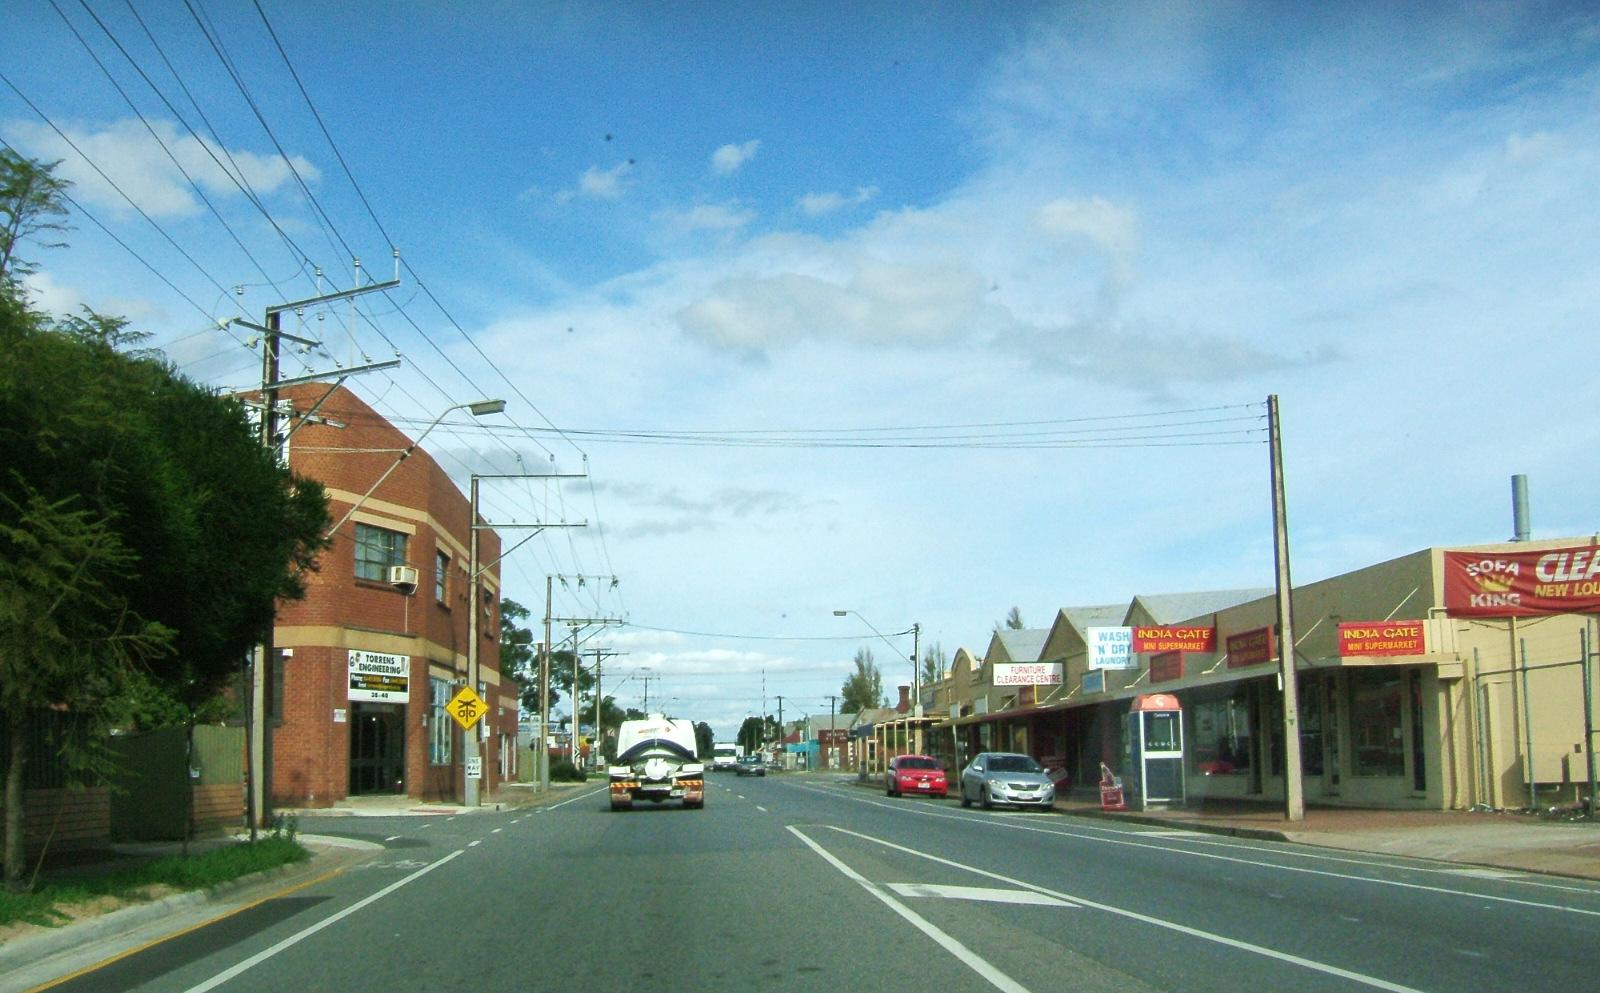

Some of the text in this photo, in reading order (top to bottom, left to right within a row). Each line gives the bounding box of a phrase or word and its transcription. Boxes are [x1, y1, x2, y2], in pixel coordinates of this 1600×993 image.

[1465, 559, 1520, 577] SOFA
[1534, 581, 1600, 598] NEW LOU
[1470, 592, 1520, 607] KING
[1097, 631, 1130, 642] WASH
[1137, 629, 1211, 640] INDIA GATE
[1343, 627, 1418, 639] INDIA GATE
[1111, 643, 1132, 655] DRY
[1143, 642, 1205, 651] MINI SUPERMARKET
[1347, 640, 1417, 651] MINI SUPERMARKET
[365, 654, 395, 665] TORRENS
[1095, 656, 1132, 665] LAUNDRY
[358, 663, 401, 675] ENGINEERING
[1010, 665, 1046, 675] FURNITURE
[996, 673, 1062, 684] CLEARANCE CENTRE
